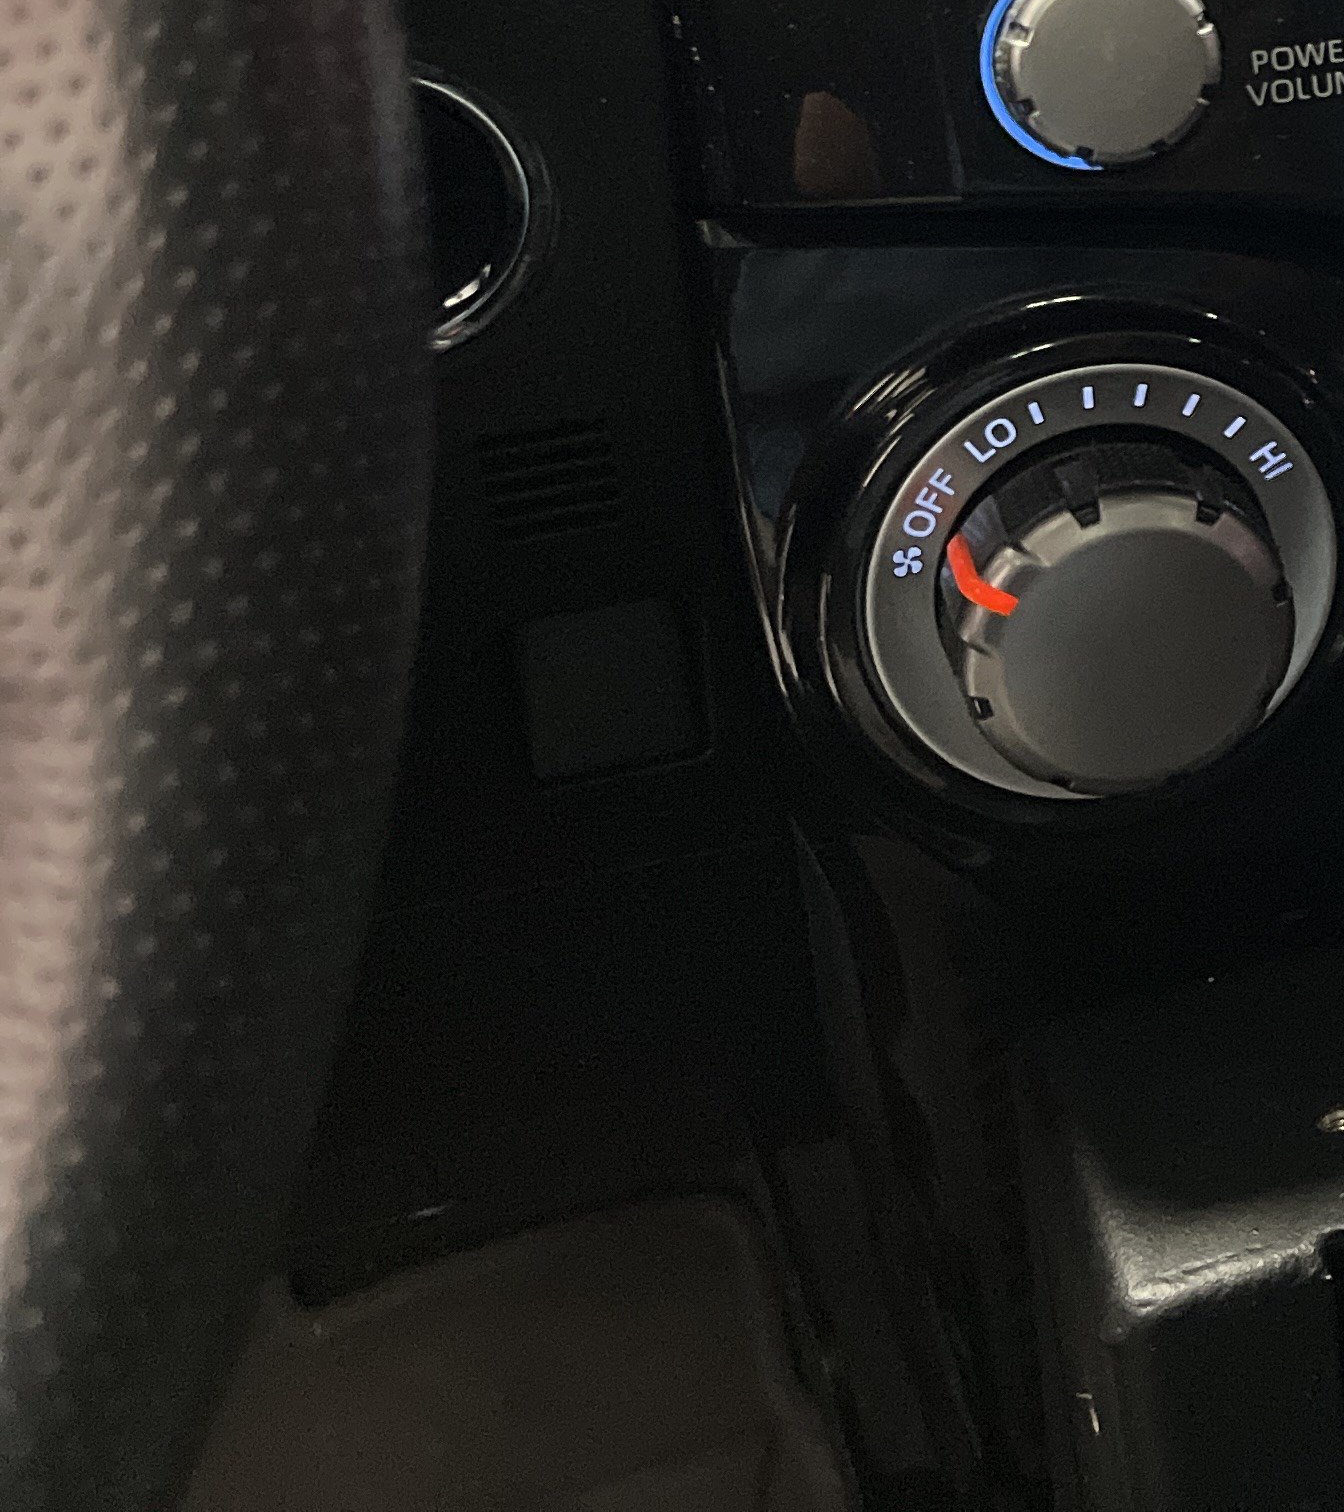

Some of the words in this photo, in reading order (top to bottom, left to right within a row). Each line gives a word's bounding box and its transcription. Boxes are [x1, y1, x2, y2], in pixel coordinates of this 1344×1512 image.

[902, 468, 957, 538] OFF
[963, 417, 1018, 464] LO
[1249, 440, 1294, 480] HI
